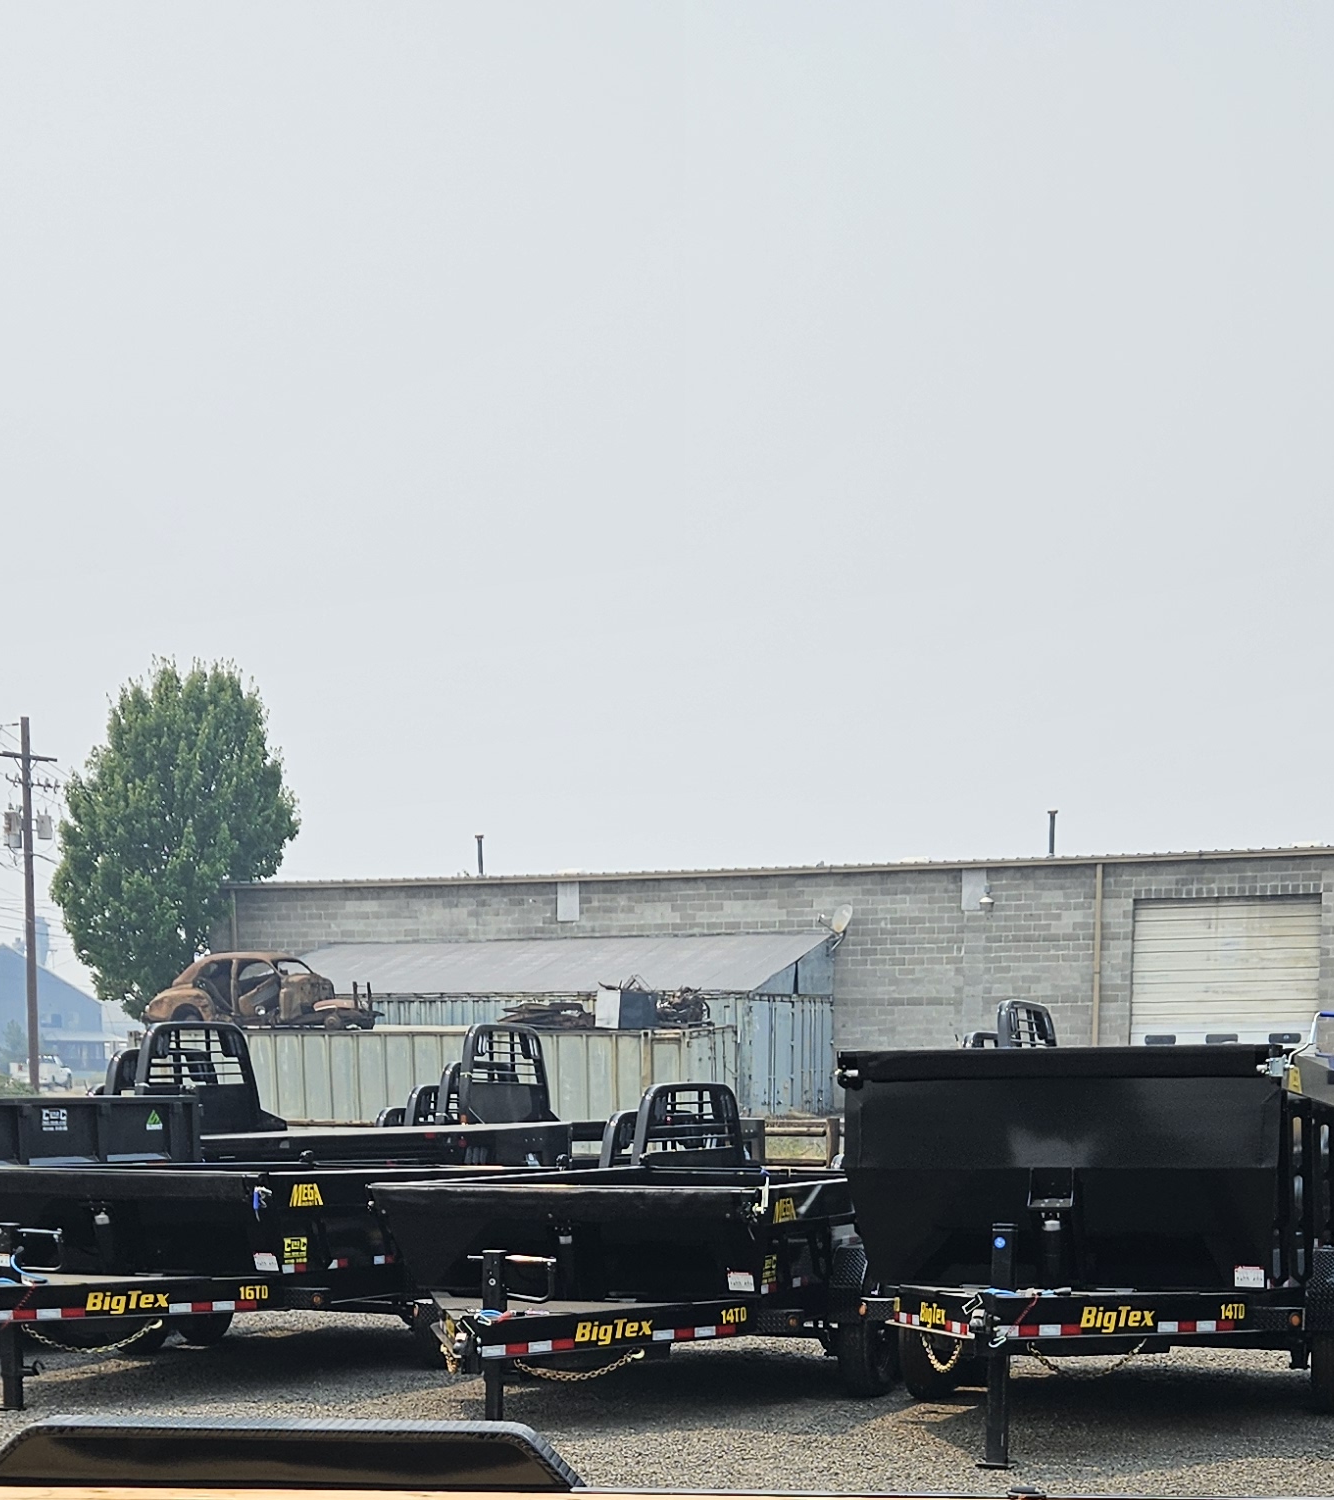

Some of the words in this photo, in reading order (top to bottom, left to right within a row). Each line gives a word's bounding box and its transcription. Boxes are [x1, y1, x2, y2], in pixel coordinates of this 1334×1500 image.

[289, 1183, 323, 1207] MEGA
[85, 1290, 170, 1314] BigTex
[239, 1285, 268, 1300] 16TD
[720, 1306, 747, 1324] 14TD
[920, 1301, 946, 1328] BigTex
[1080, 1305, 1156, 1333] BigTex
[1220, 1303, 1245, 1319] 14TD
[575, 1318, 653, 1346] BigTex
